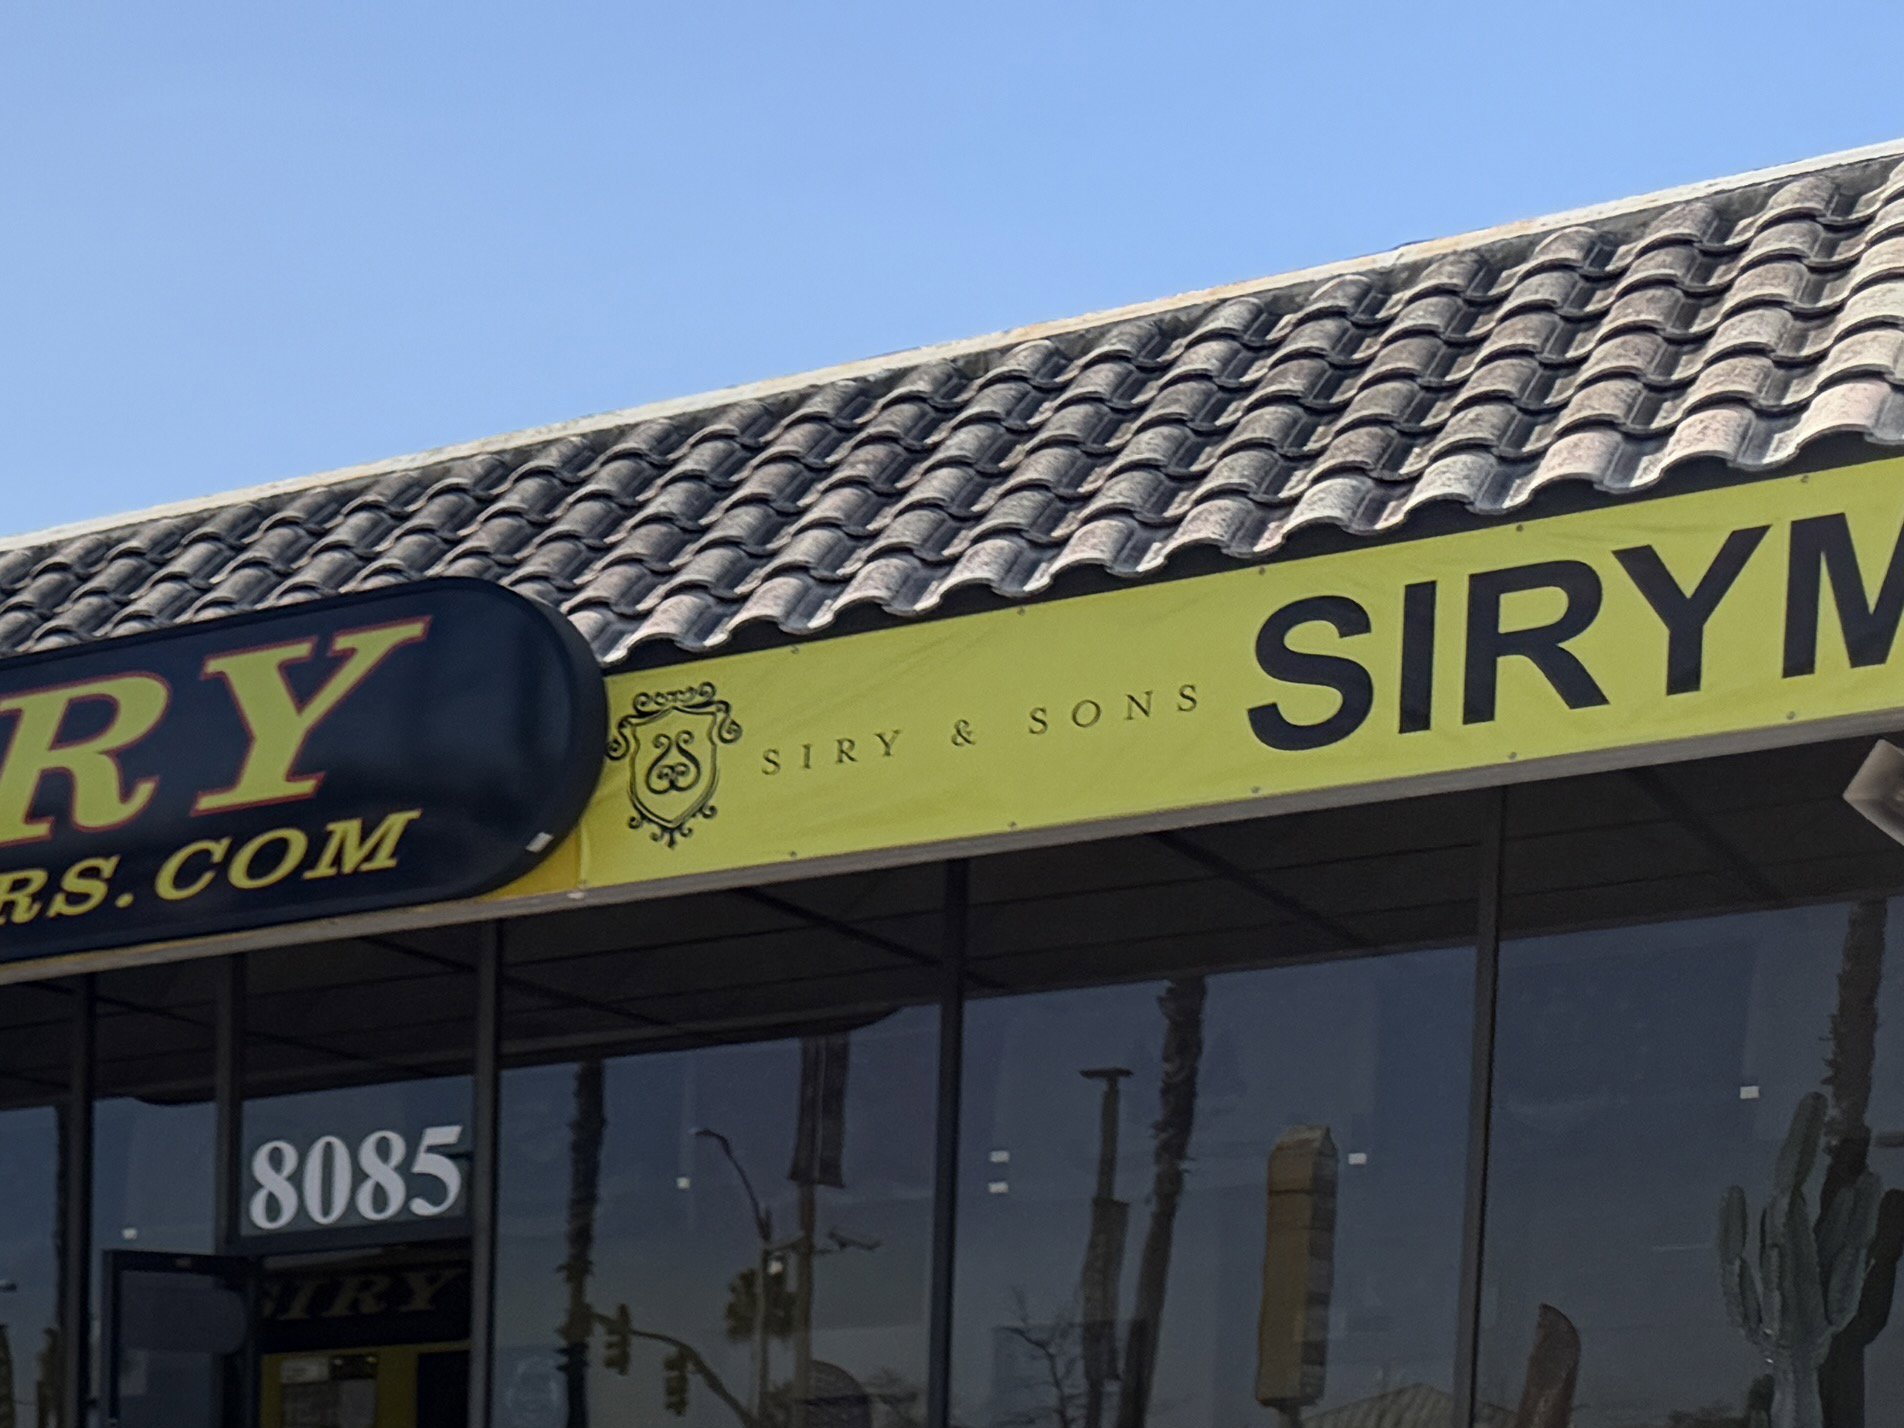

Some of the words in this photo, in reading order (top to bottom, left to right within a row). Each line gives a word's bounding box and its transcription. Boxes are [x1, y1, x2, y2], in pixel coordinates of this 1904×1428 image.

[1247, 511, 1904, 752] SIRYM
[761, 728, 906, 777] SIRY
[951, 722, 977, 749] &
[1029, 681, 1204, 737] SONS
[249, 1124, 463, 1231] 8085
